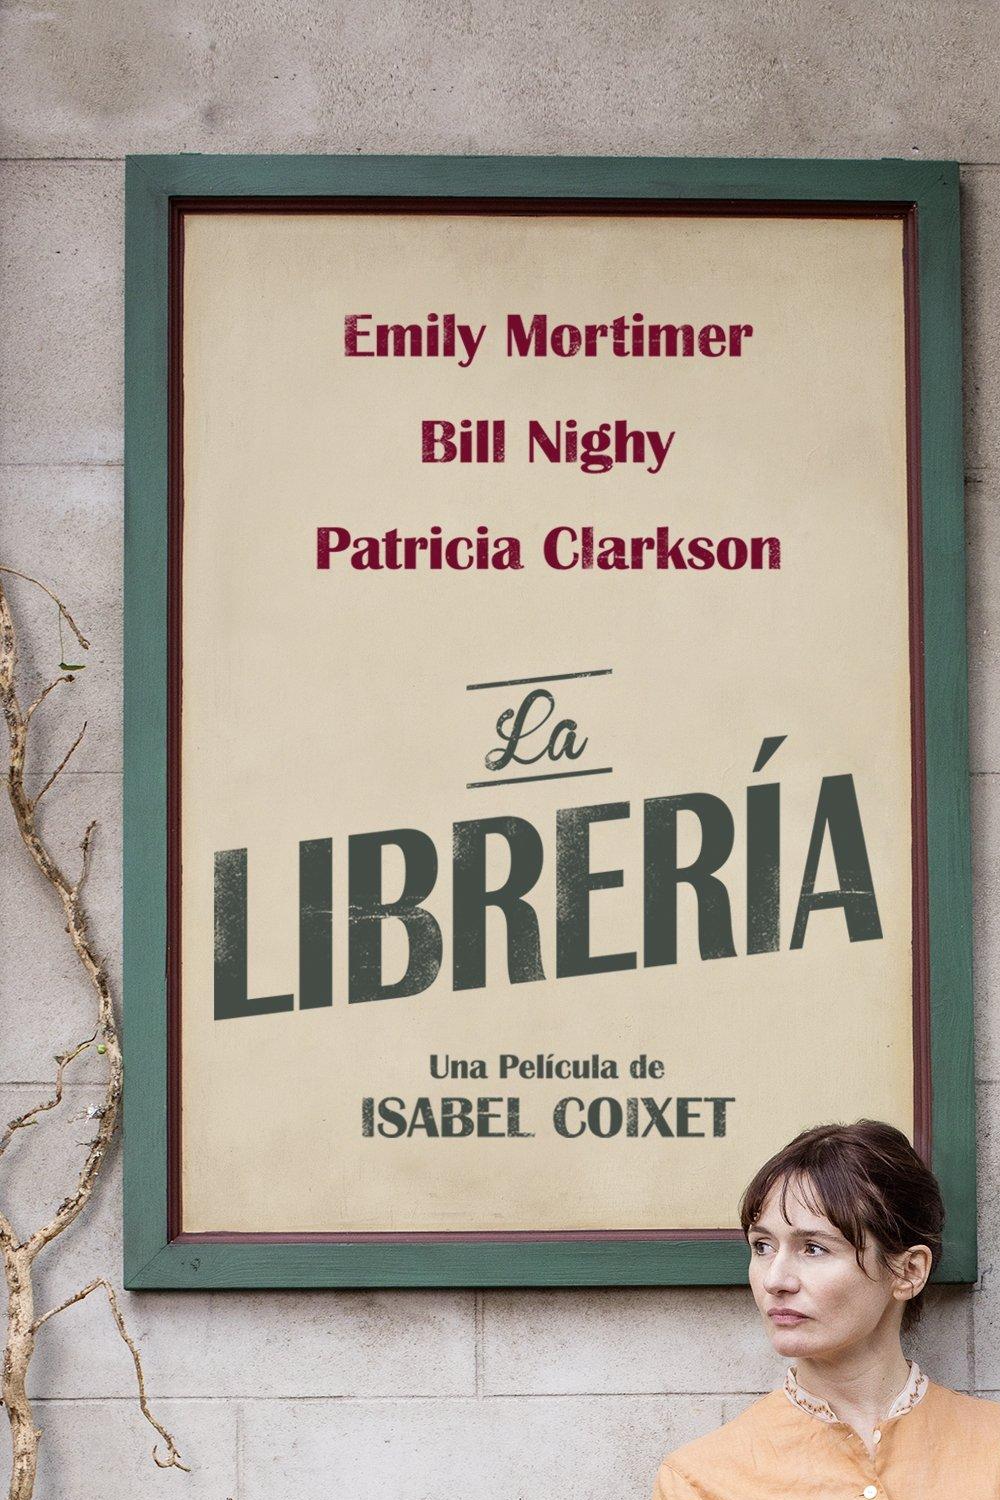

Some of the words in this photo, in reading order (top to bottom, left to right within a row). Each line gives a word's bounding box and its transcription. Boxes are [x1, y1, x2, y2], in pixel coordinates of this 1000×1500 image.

[345, 313, 486, 367] Emily
[507, 313, 753, 357] Mortimer
[422, 420, 505, 463] Bill
[529, 420, 675, 474] Nighy
[317, 526, 524, 570] Patricia
[544, 526, 781, 570] Clarkson
[484, 689, 588, 772] La
[214, 735, 883, 1021] LIBRERÍA
[430, 1055, 488, 1079] Una
[500, 1054, 619, 1079] Película
[630, 1054, 664, 1079] de
[362, 1097, 535, 1138] ISABEL
[553, 1097, 735, 1138] COIXET
